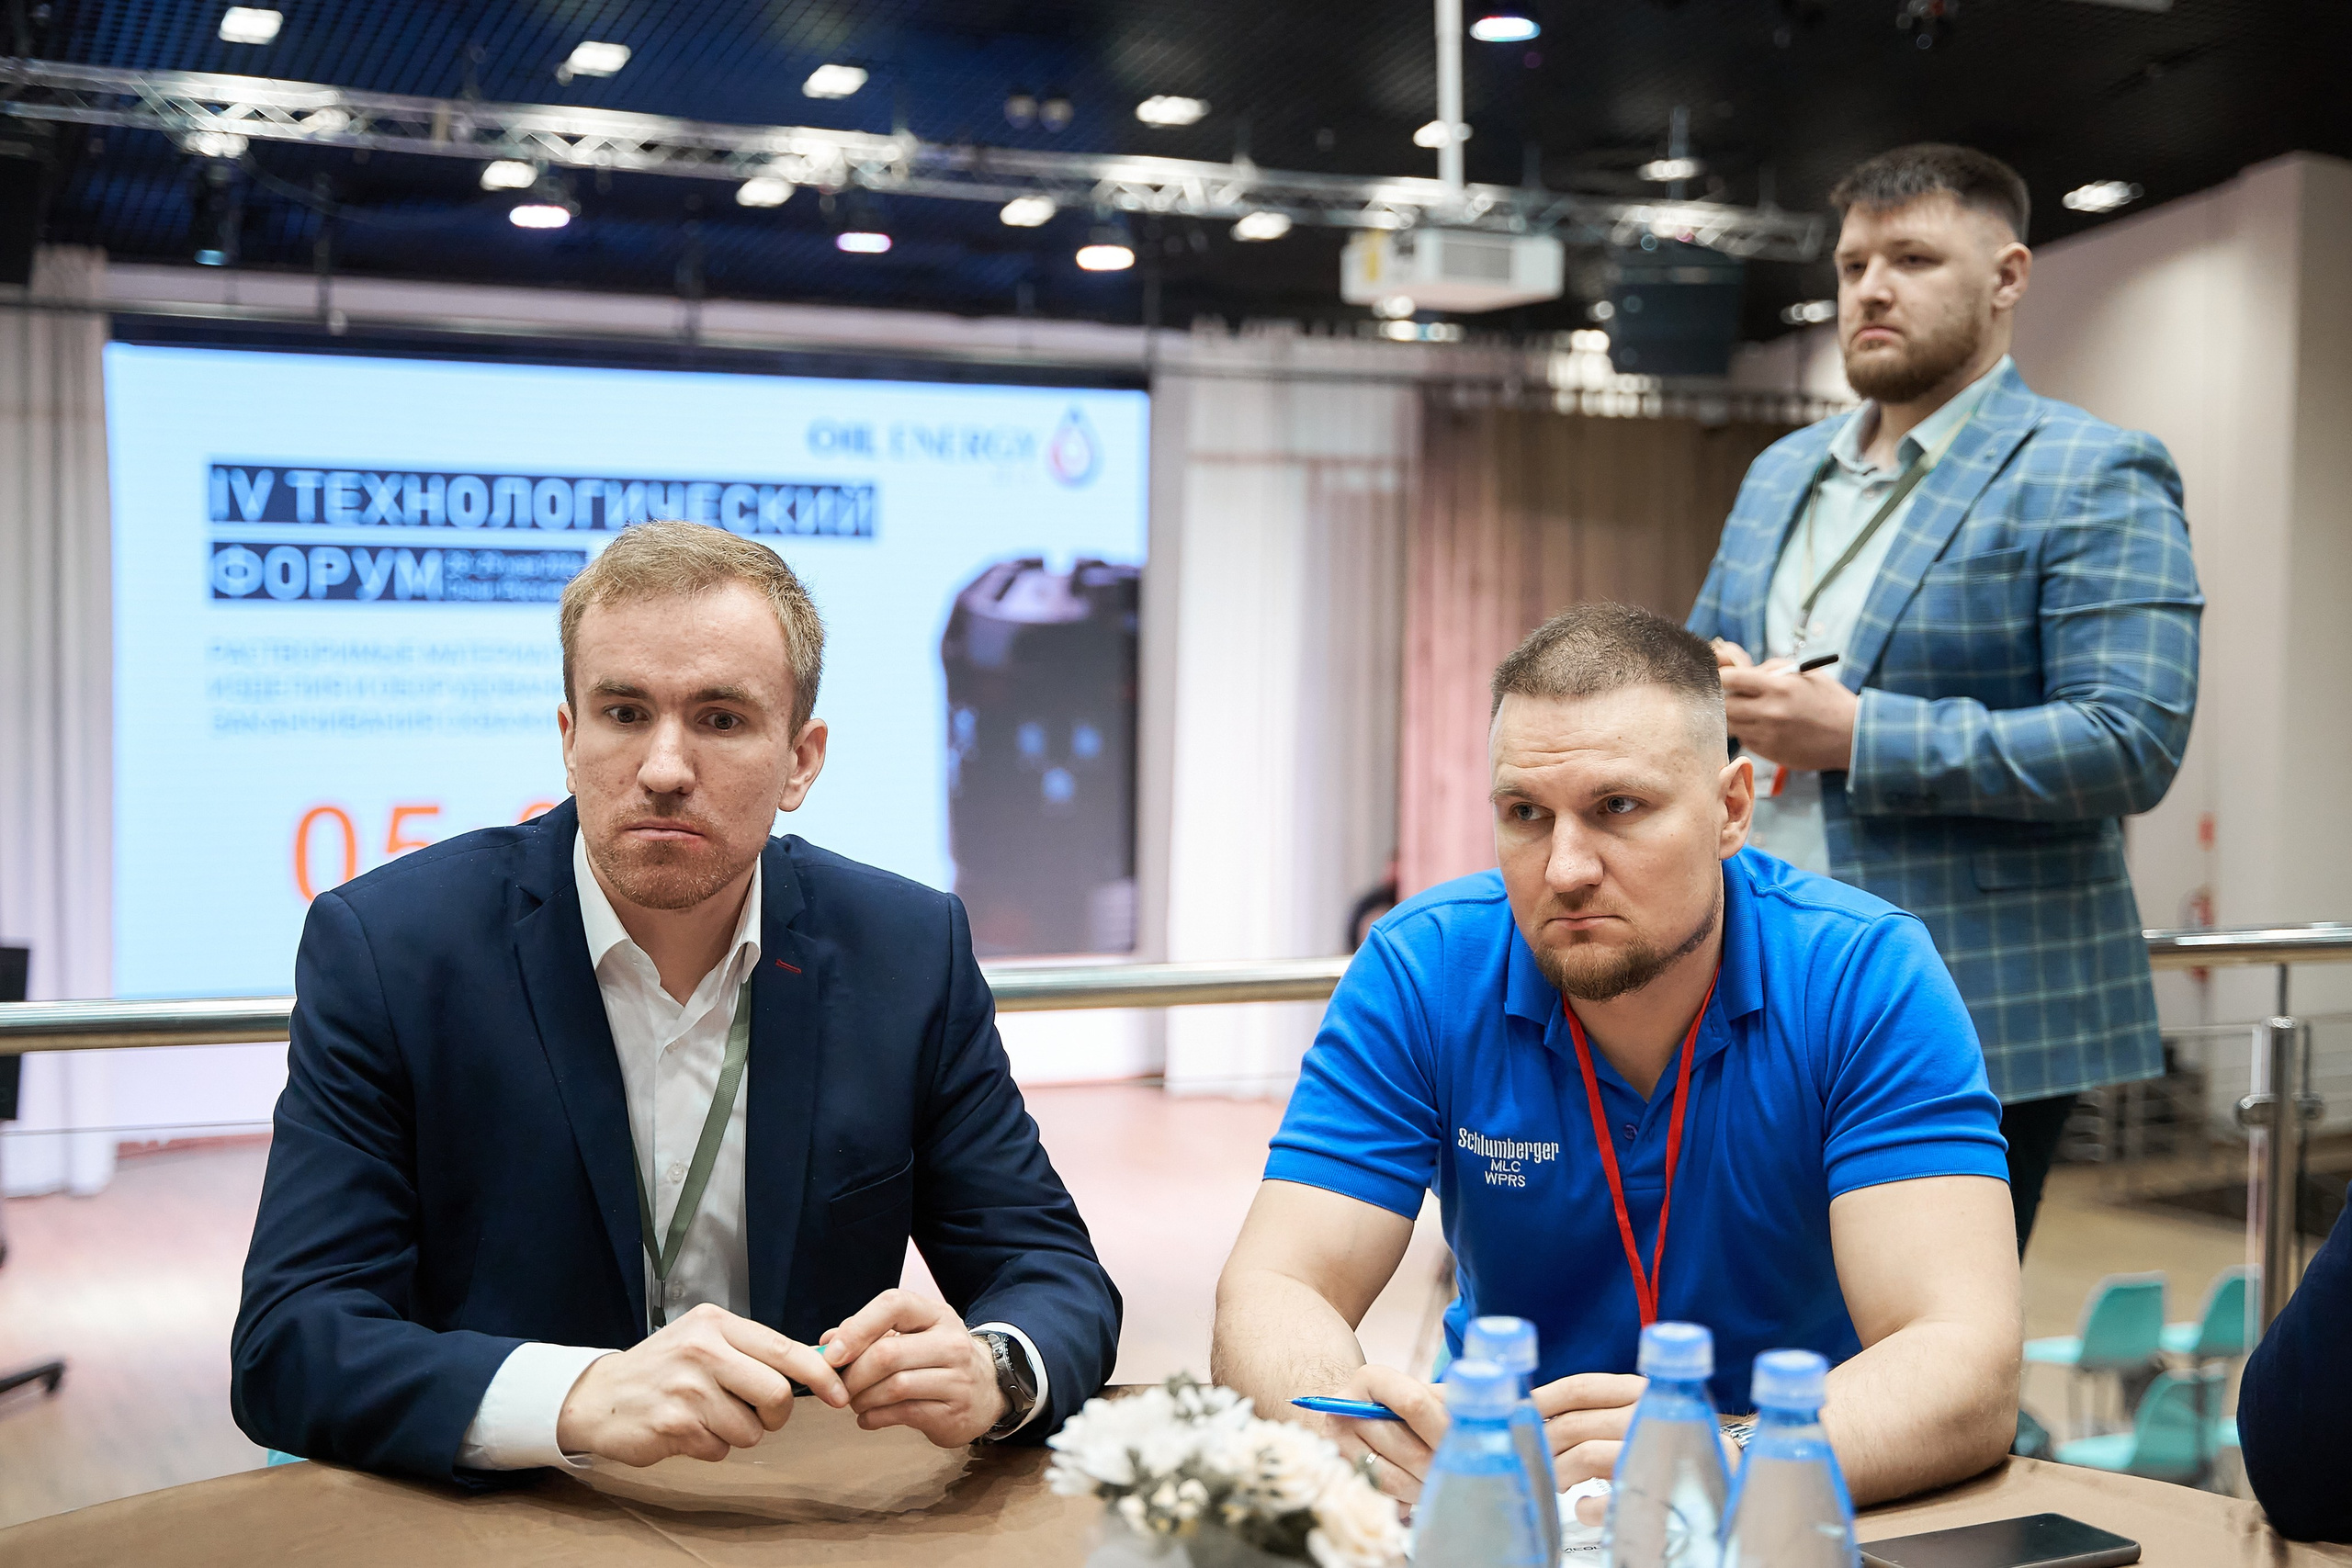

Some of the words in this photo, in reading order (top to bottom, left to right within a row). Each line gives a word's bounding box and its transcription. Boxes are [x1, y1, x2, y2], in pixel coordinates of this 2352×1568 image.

[807, 418, 876, 458] OIL
[209, 467, 275, 523] IV
[283, 469, 874, 536] ТЕХНОЛОГИЧЕСКИЙ
[211, 544, 444, 602] ФОРУМ
[1458, 1127, 1559, 1164] Schlumberger
[1485, 1170, 1526, 1188] WPRS
[1490, 1158, 1521, 1173] MLC
